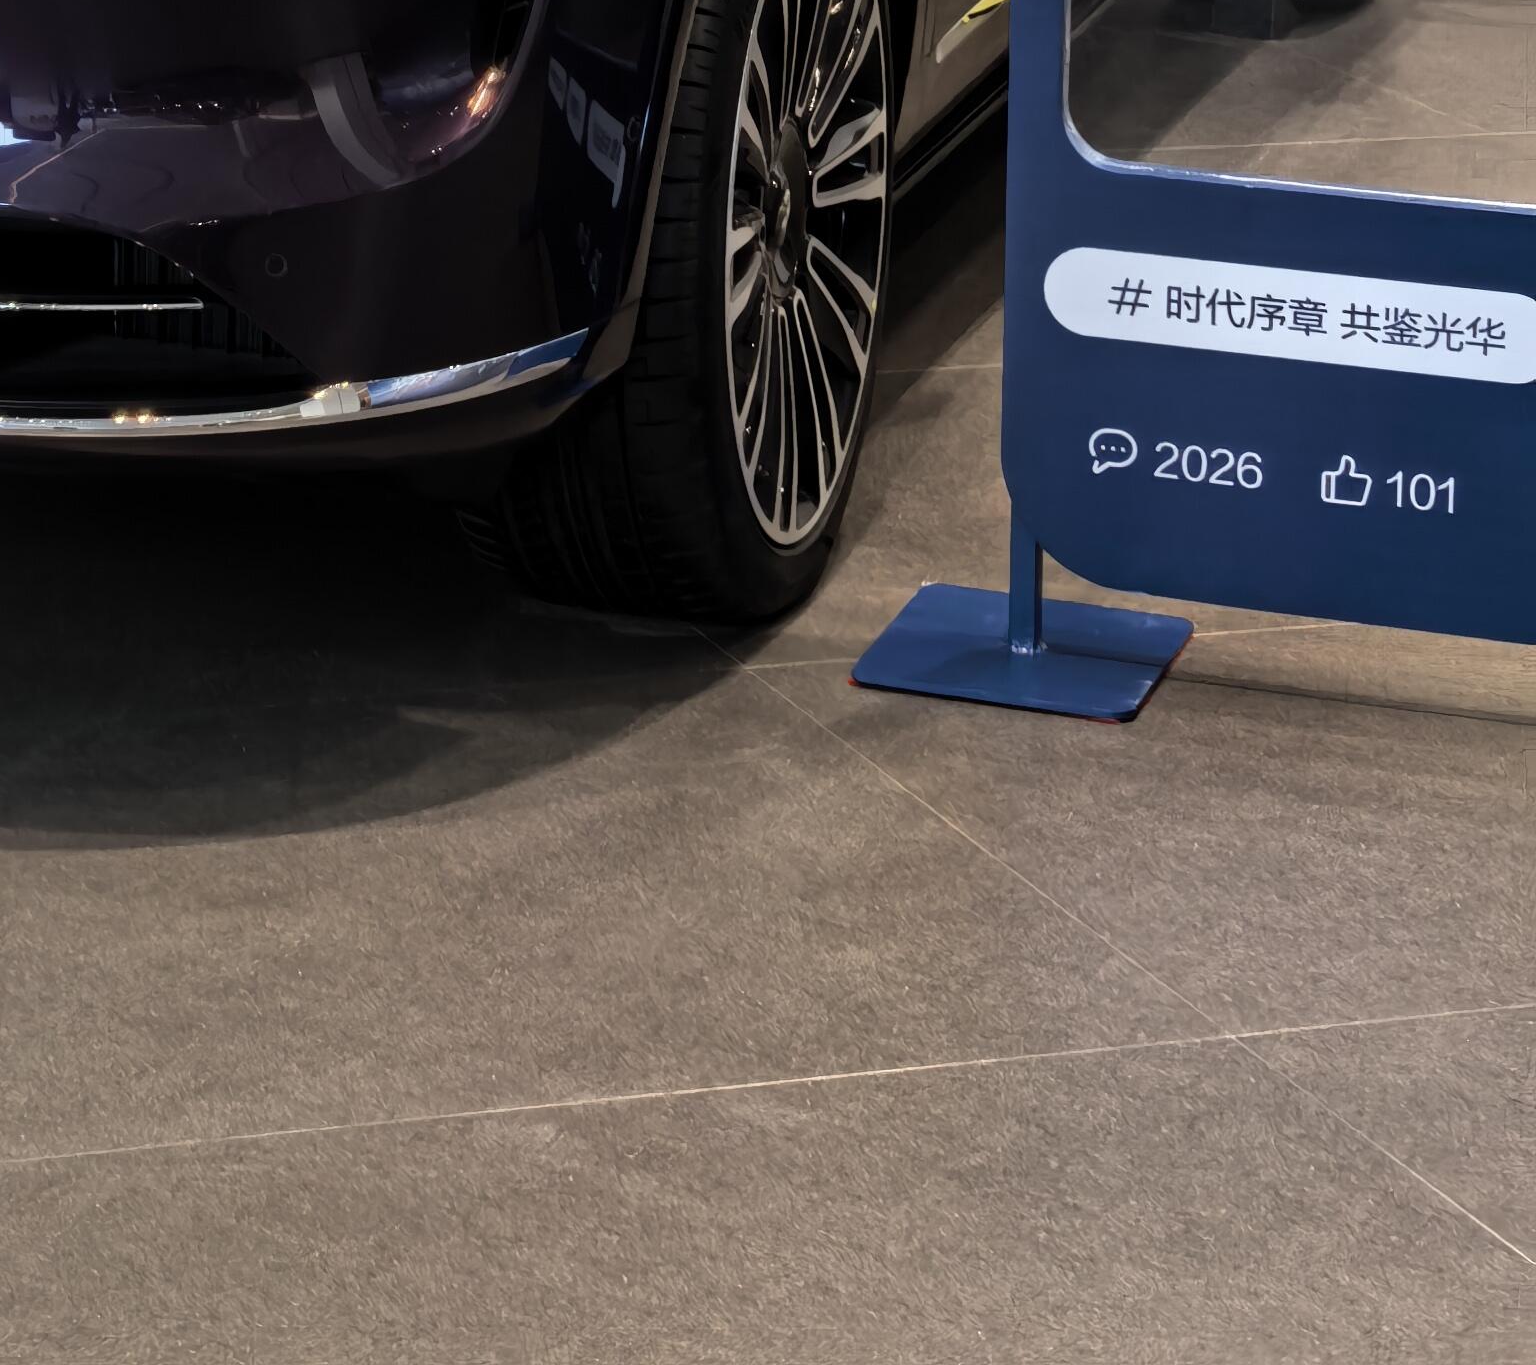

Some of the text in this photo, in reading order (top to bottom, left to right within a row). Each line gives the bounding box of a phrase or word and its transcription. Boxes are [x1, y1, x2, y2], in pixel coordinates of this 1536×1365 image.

[1166, 285, 1328, 337] 时代序章
[1340, 302, 1507, 357] 共鉴光华
[1153, 441, 1456, 514] 2026 101
